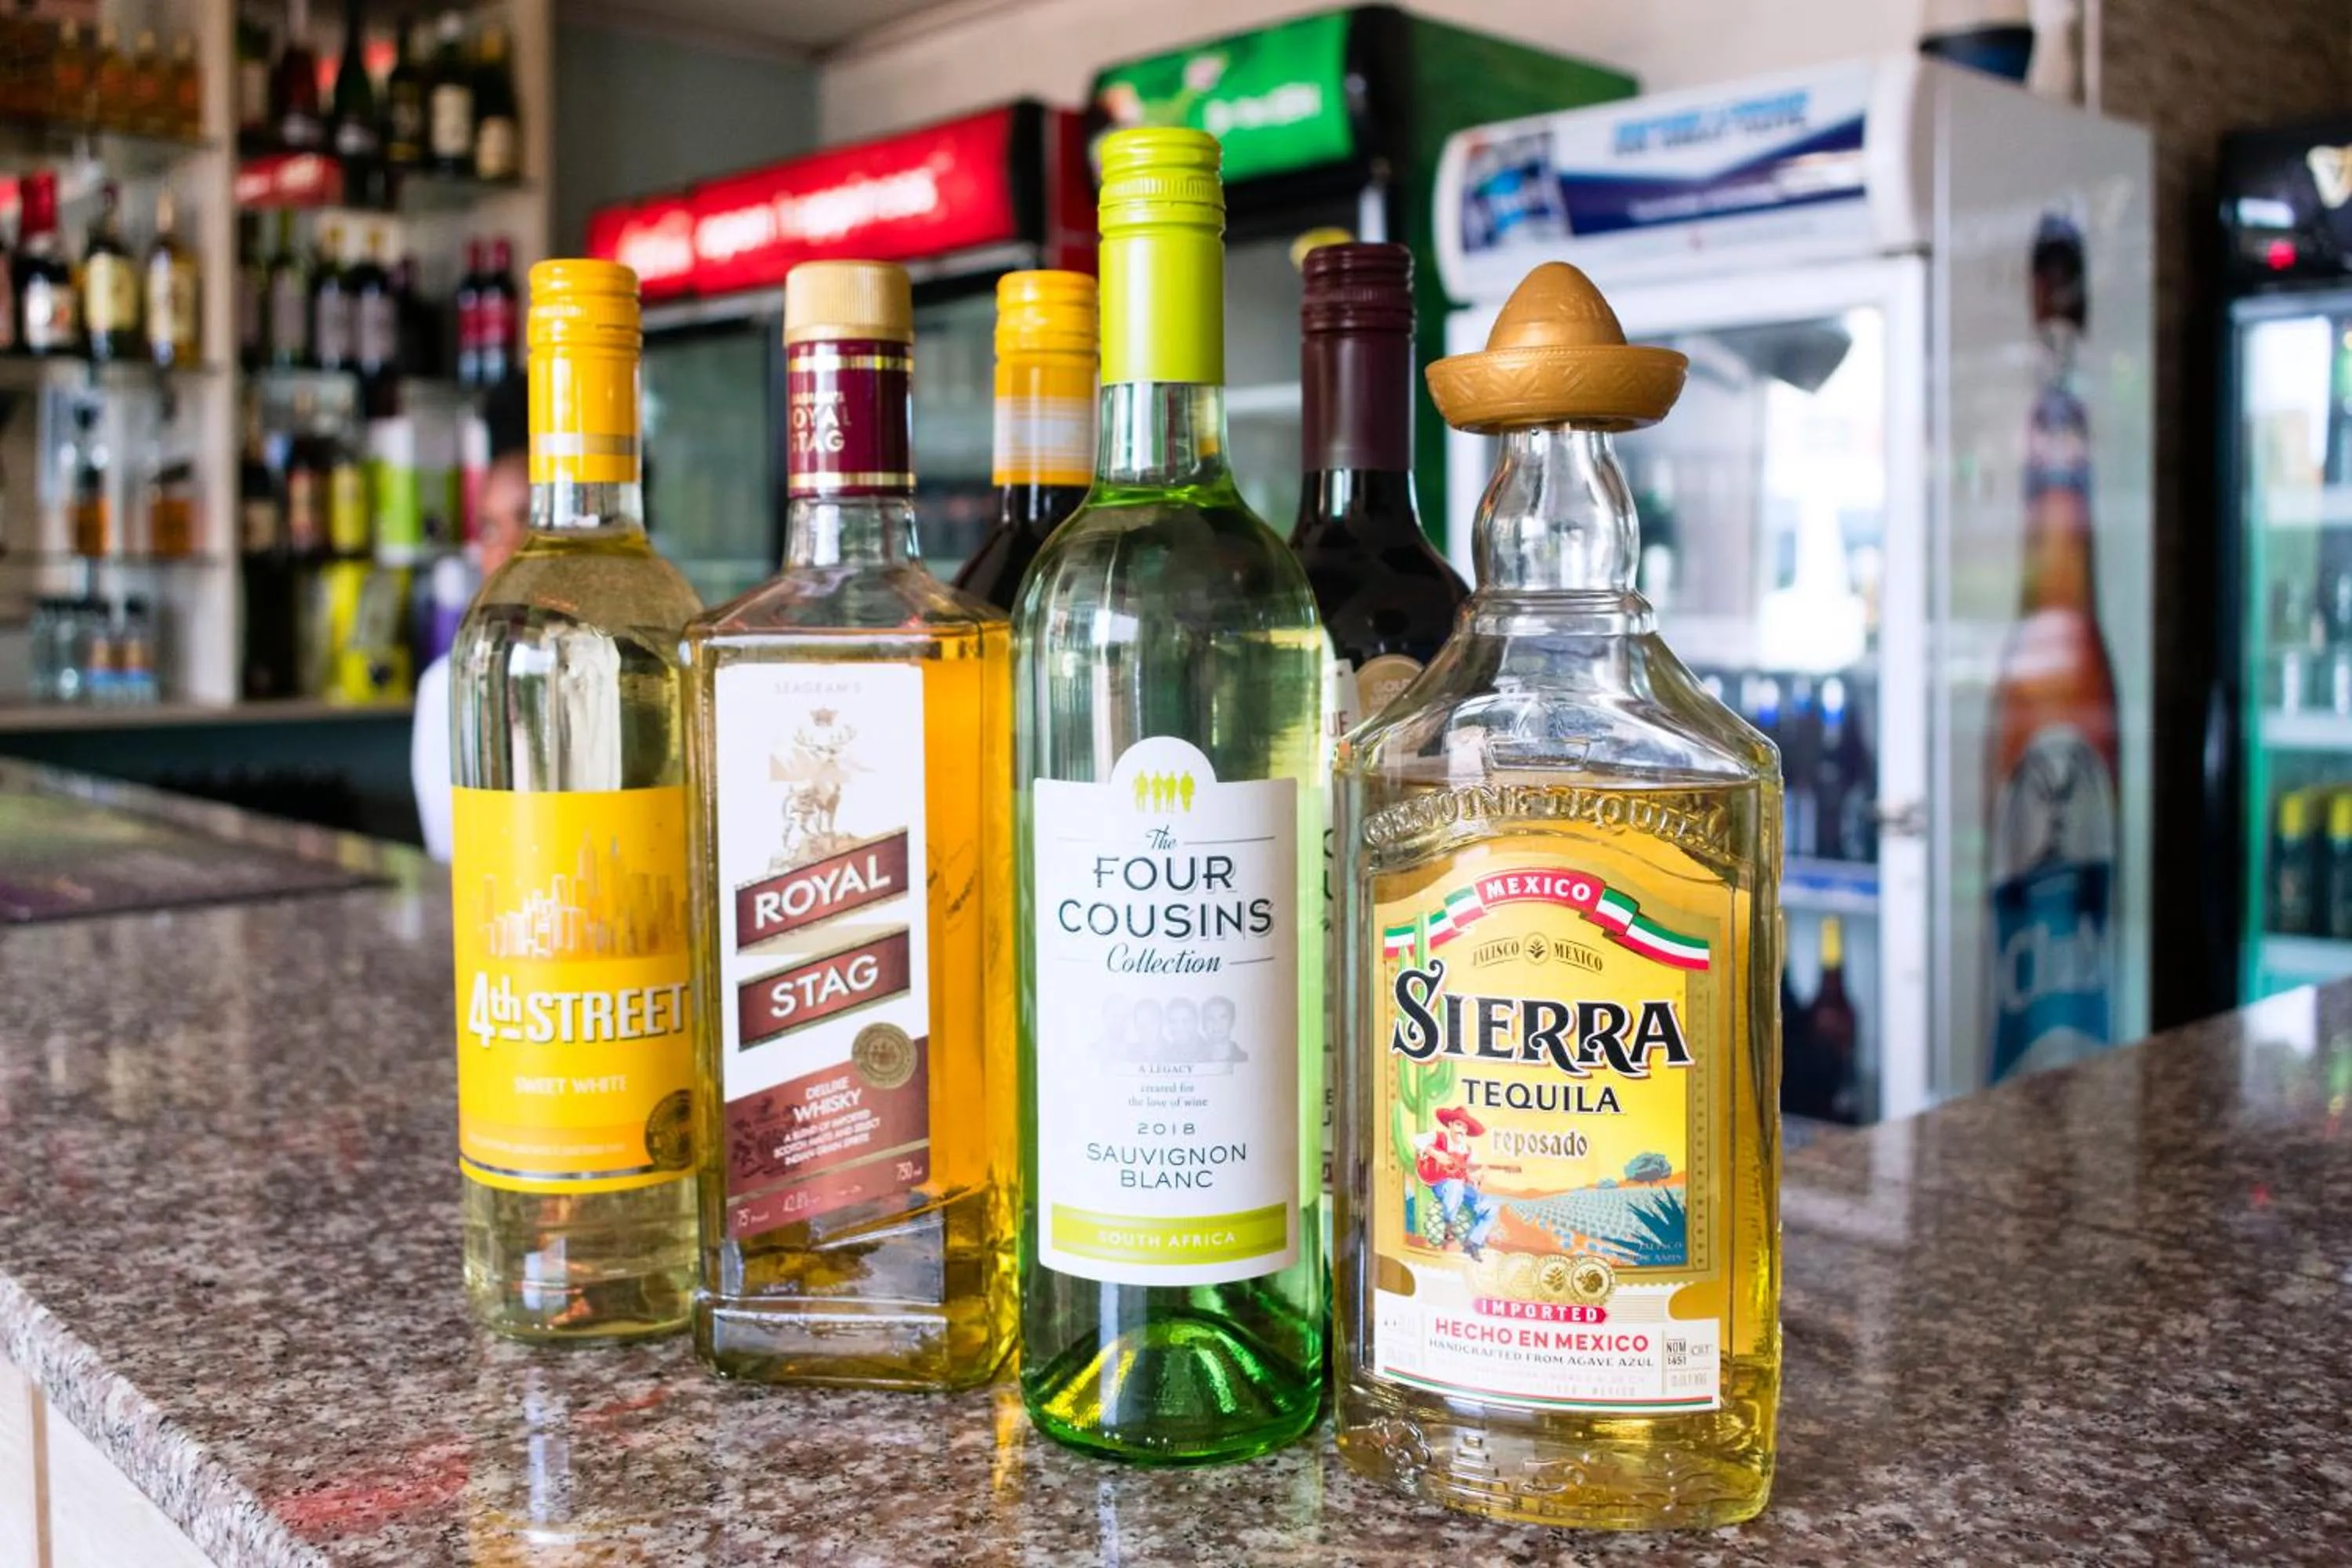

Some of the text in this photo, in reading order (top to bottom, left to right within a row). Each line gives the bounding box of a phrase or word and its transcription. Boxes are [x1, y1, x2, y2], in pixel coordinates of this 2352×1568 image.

[1146, 825, 1176, 850] The
[1093, 855, 1236, 891] FOUR
[755, 855, 891, 928] ROYAL
[1486, 876, 1591, 902] MEXICO
[1059, 898, 1273, 939] COUSINS
[1107, 942, 1221, 974] Collection
[1472, 941, 1603, 971] JALISCO MEXICO
[771, 954, 879, 1018] STAG
[468, 971, 688, 1049] 4th STREET
[1392, 959, 1693, 1077] SIERRA
[514, 1073, 626, 1094] SWEET WHITE
[1149, 1065, 1194, 1074] LEGACY
[1128, 1095, 1208, 1107] the love of wine
[1141, 1082, 1177, 1093] created
[1461, 1079, 1621, 1113] TEQUILA
[793, 1087, 862, 1123] WHISKY
[1138, 1123, 1196, 1134] 2018
[1493, 1124, 1588, 1157] reposado
[1087, 1143, 1246, 1166] SAUVIGNON
[1120, 1170, 1214, 1189] BLANC
[1098, 1231, 1237, 1248] SOUTH AFRICA
[1481, 1298, 1598, 1323] IMPORTED
[1436, 1316, 1512, 1345] HECHO
[1519, 1330, 1549, 1348] EN
[1555, 1334, 1650, 1352] MEXICO
[1666, 1341, 1686, 1354] NOM
[1429, 1338, 1654, 1367] HANDCRAFTED FROM AGAVE AZUL
